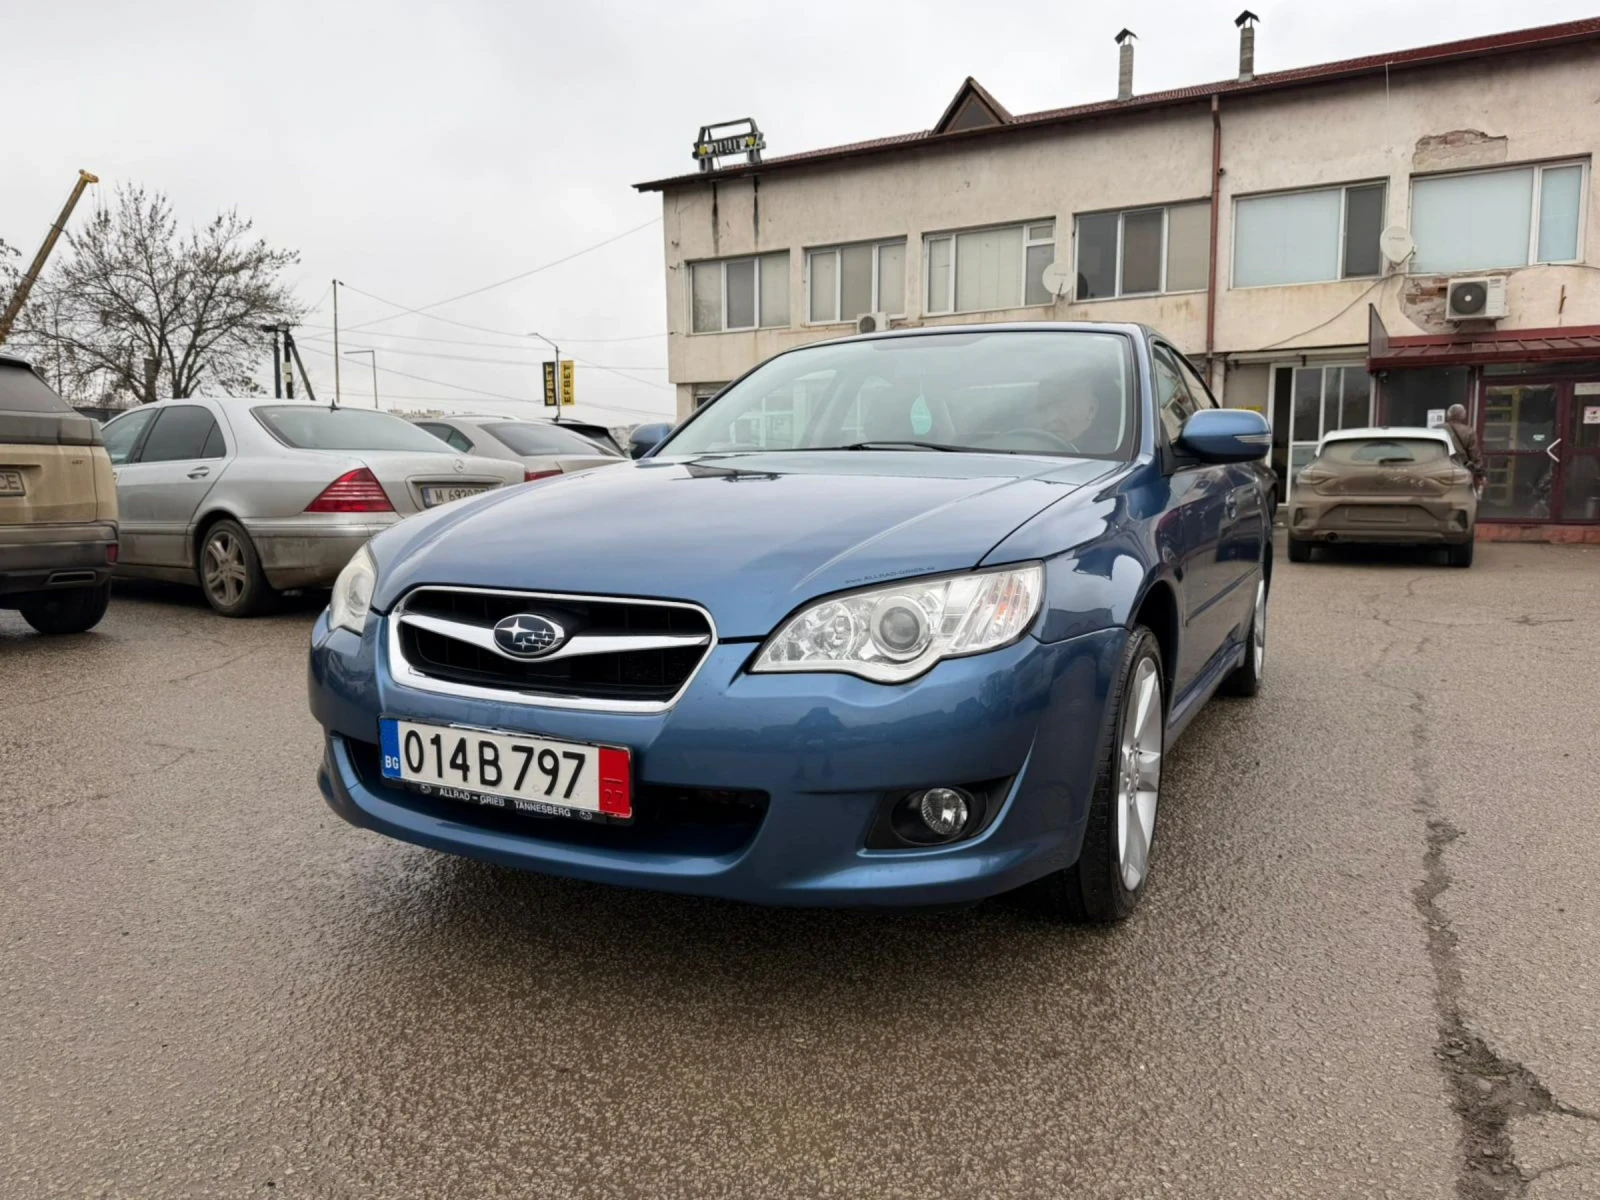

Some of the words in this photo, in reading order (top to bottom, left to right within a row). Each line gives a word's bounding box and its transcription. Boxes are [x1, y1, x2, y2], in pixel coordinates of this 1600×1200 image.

[545, 365, 554, 404] EFBET
[385, 755, 399, 769] BG
[439, 788, 470, 801] ALLRAD
[479, 794, 505, 807] GRIEB
[514, 799, 571, 817] TANNESBERG
